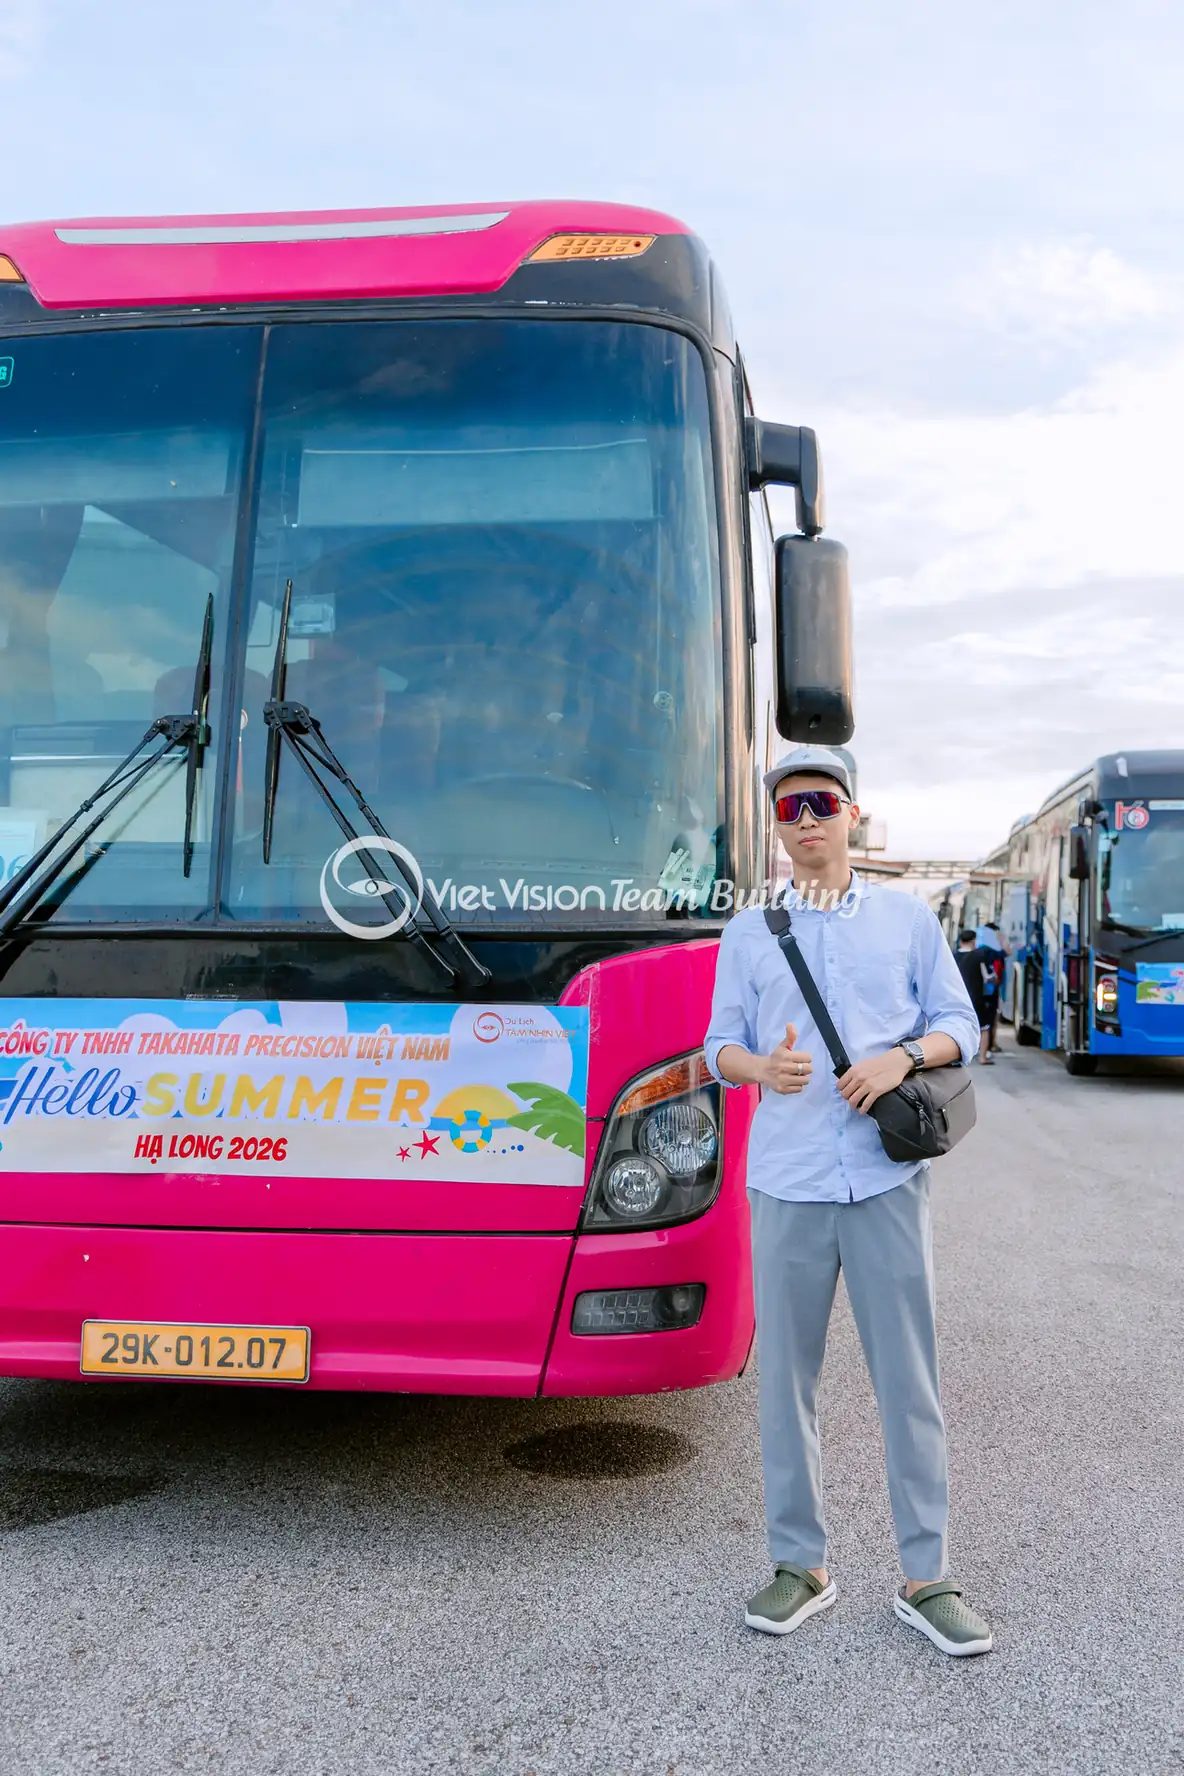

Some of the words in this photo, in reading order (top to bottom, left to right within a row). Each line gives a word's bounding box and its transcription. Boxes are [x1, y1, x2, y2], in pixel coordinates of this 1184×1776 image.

[54, 1031, 79, 1055] TY
[81, 1032, 134, 1055] TNHH
[137, 1032, 241, 1056] TAKAHATA
[243, 1034, 354, 1058] PRECISION
[355, 1027, 398, 1066] VIỆT
[401, 1037, 450, 1061] NAM
[3, 1066, 141, 1125] Hello
[141, 1072, 430, 1123] SUMMER
[134, 1134, 163, 1165] HẠ
[168, 1134, 224, 1160] LONG
[227, 1136, 289, 1162] 2026
[101, 1332, 286, 1369] 29K-012.07
